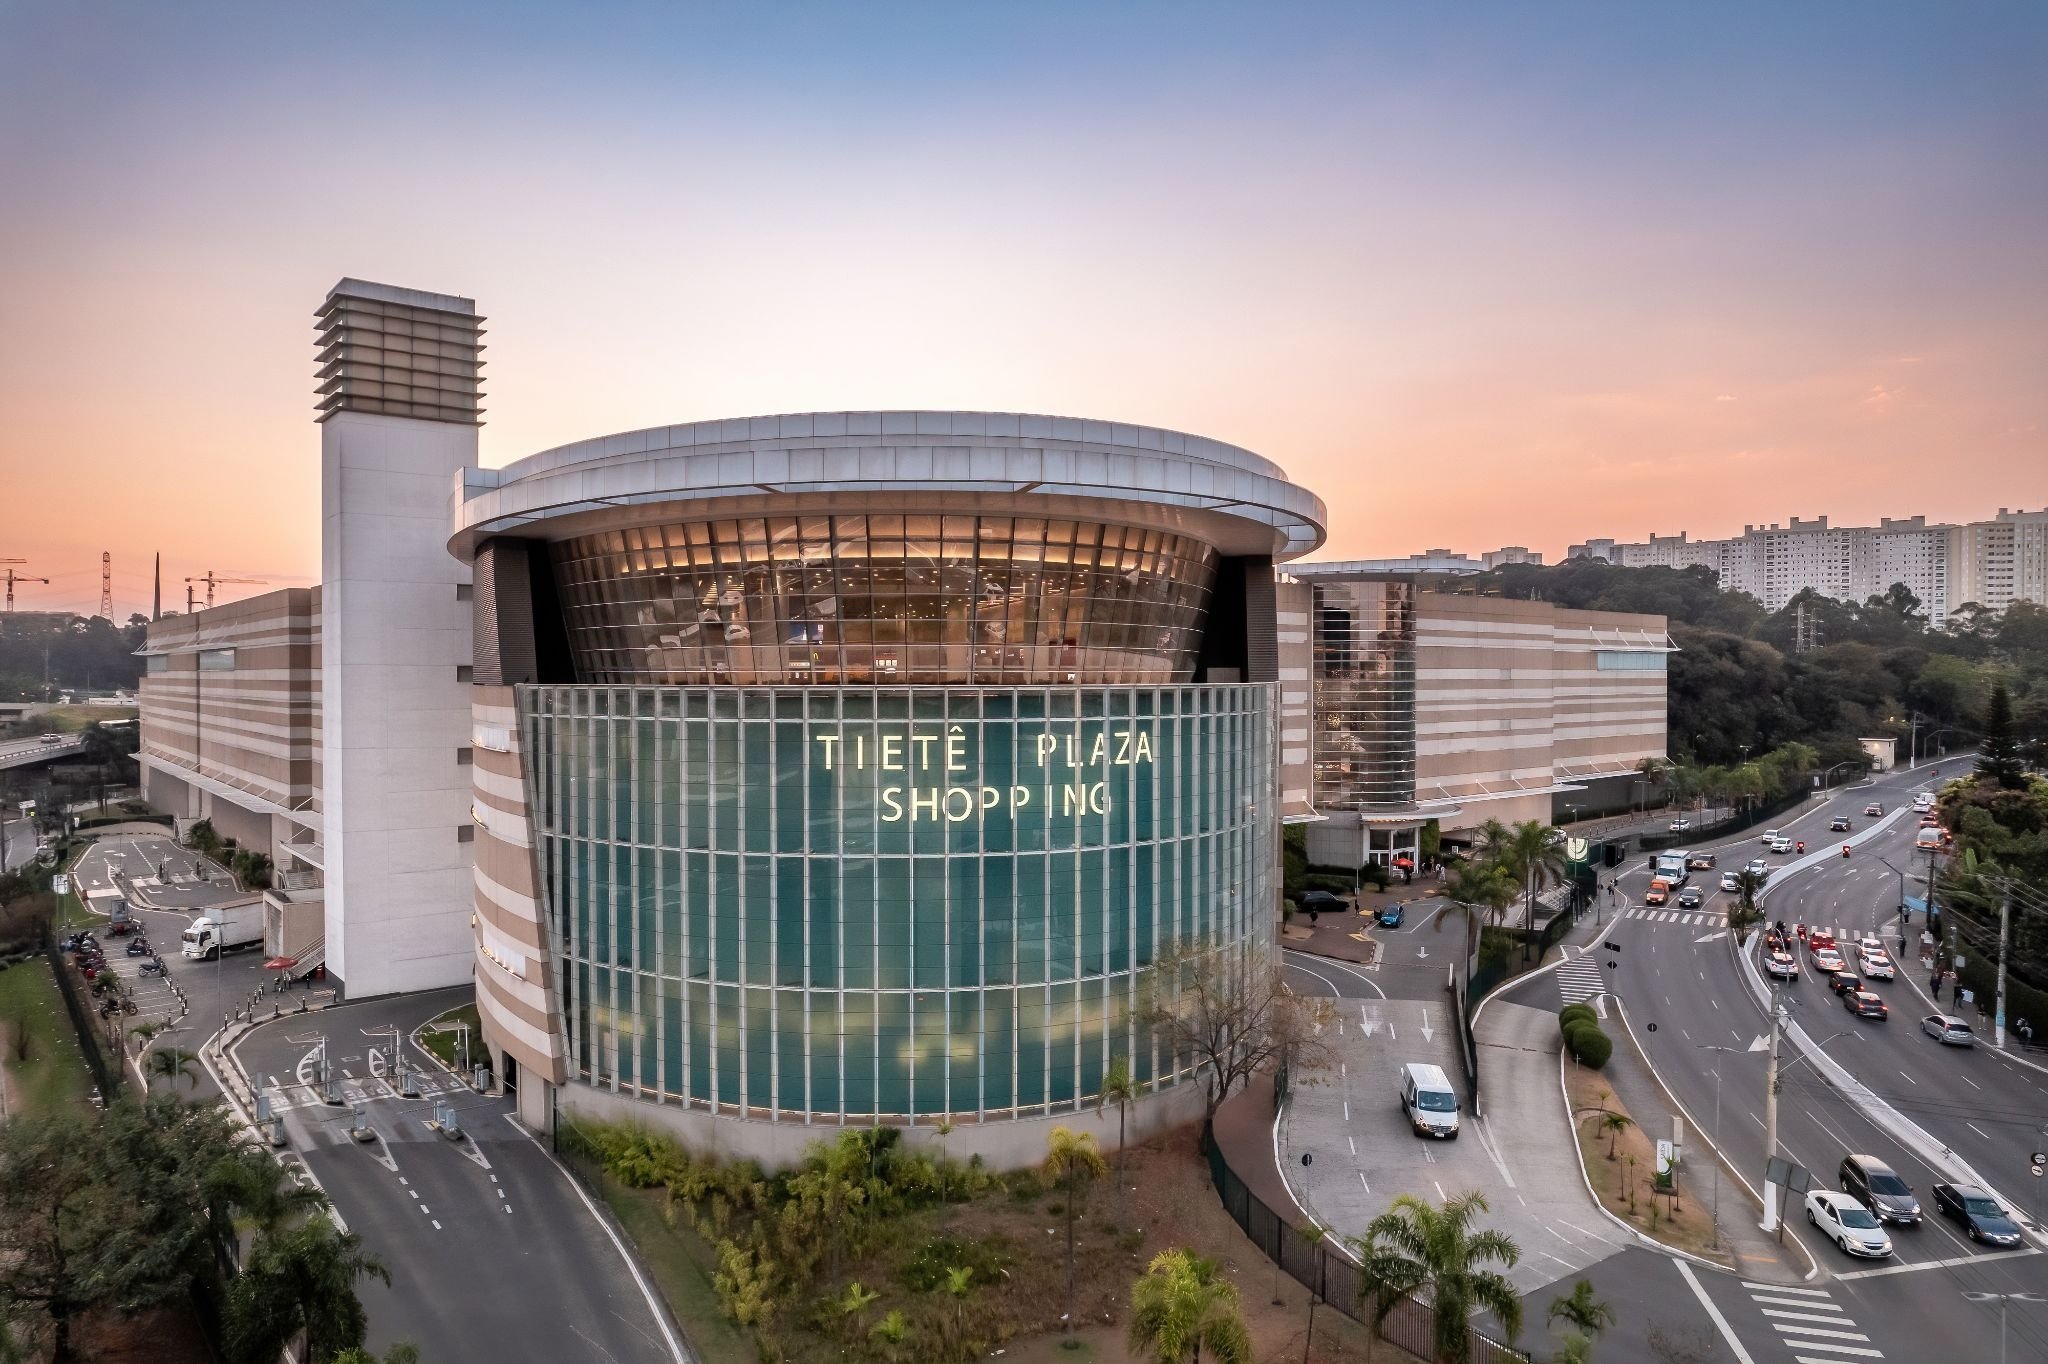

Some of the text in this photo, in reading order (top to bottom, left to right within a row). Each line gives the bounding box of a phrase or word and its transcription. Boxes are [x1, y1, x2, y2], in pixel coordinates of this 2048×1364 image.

[816, 725, 1153, 770] TIETÊ PLAZA
[881, 781, 1112, 822] SHOPPING
